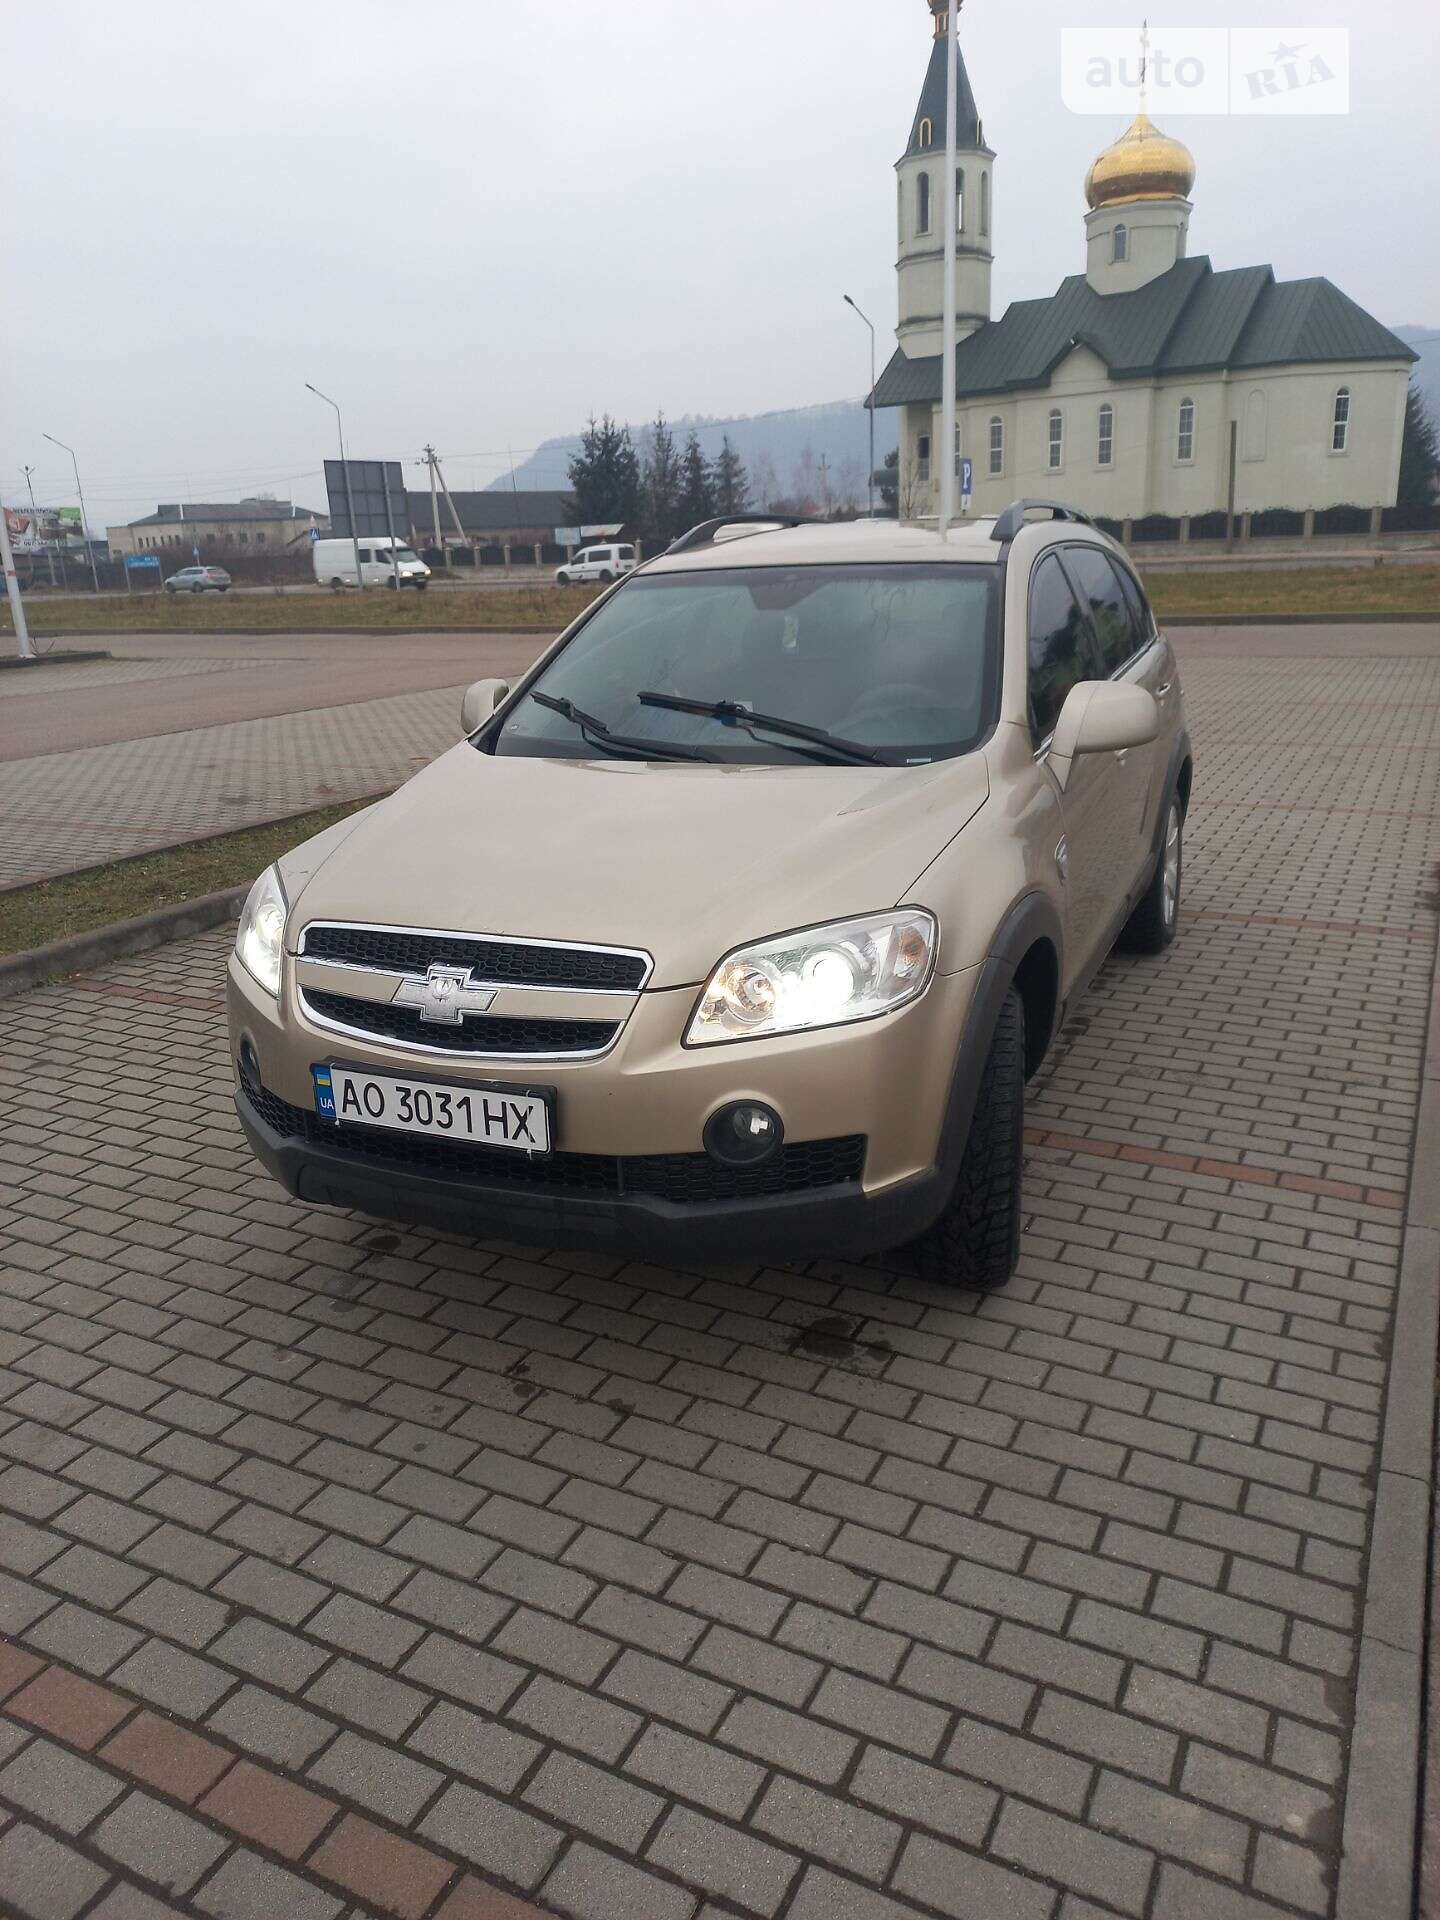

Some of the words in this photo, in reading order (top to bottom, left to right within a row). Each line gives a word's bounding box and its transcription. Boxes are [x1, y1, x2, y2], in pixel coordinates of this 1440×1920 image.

[963, 463, 971, 489] P
[320, 1098, 334, 1110] UA
[341, 1078, 386, 1118] AO
[395, 1085, 473, 1134] 3031
[482, 1098, 536, 1144] HX
